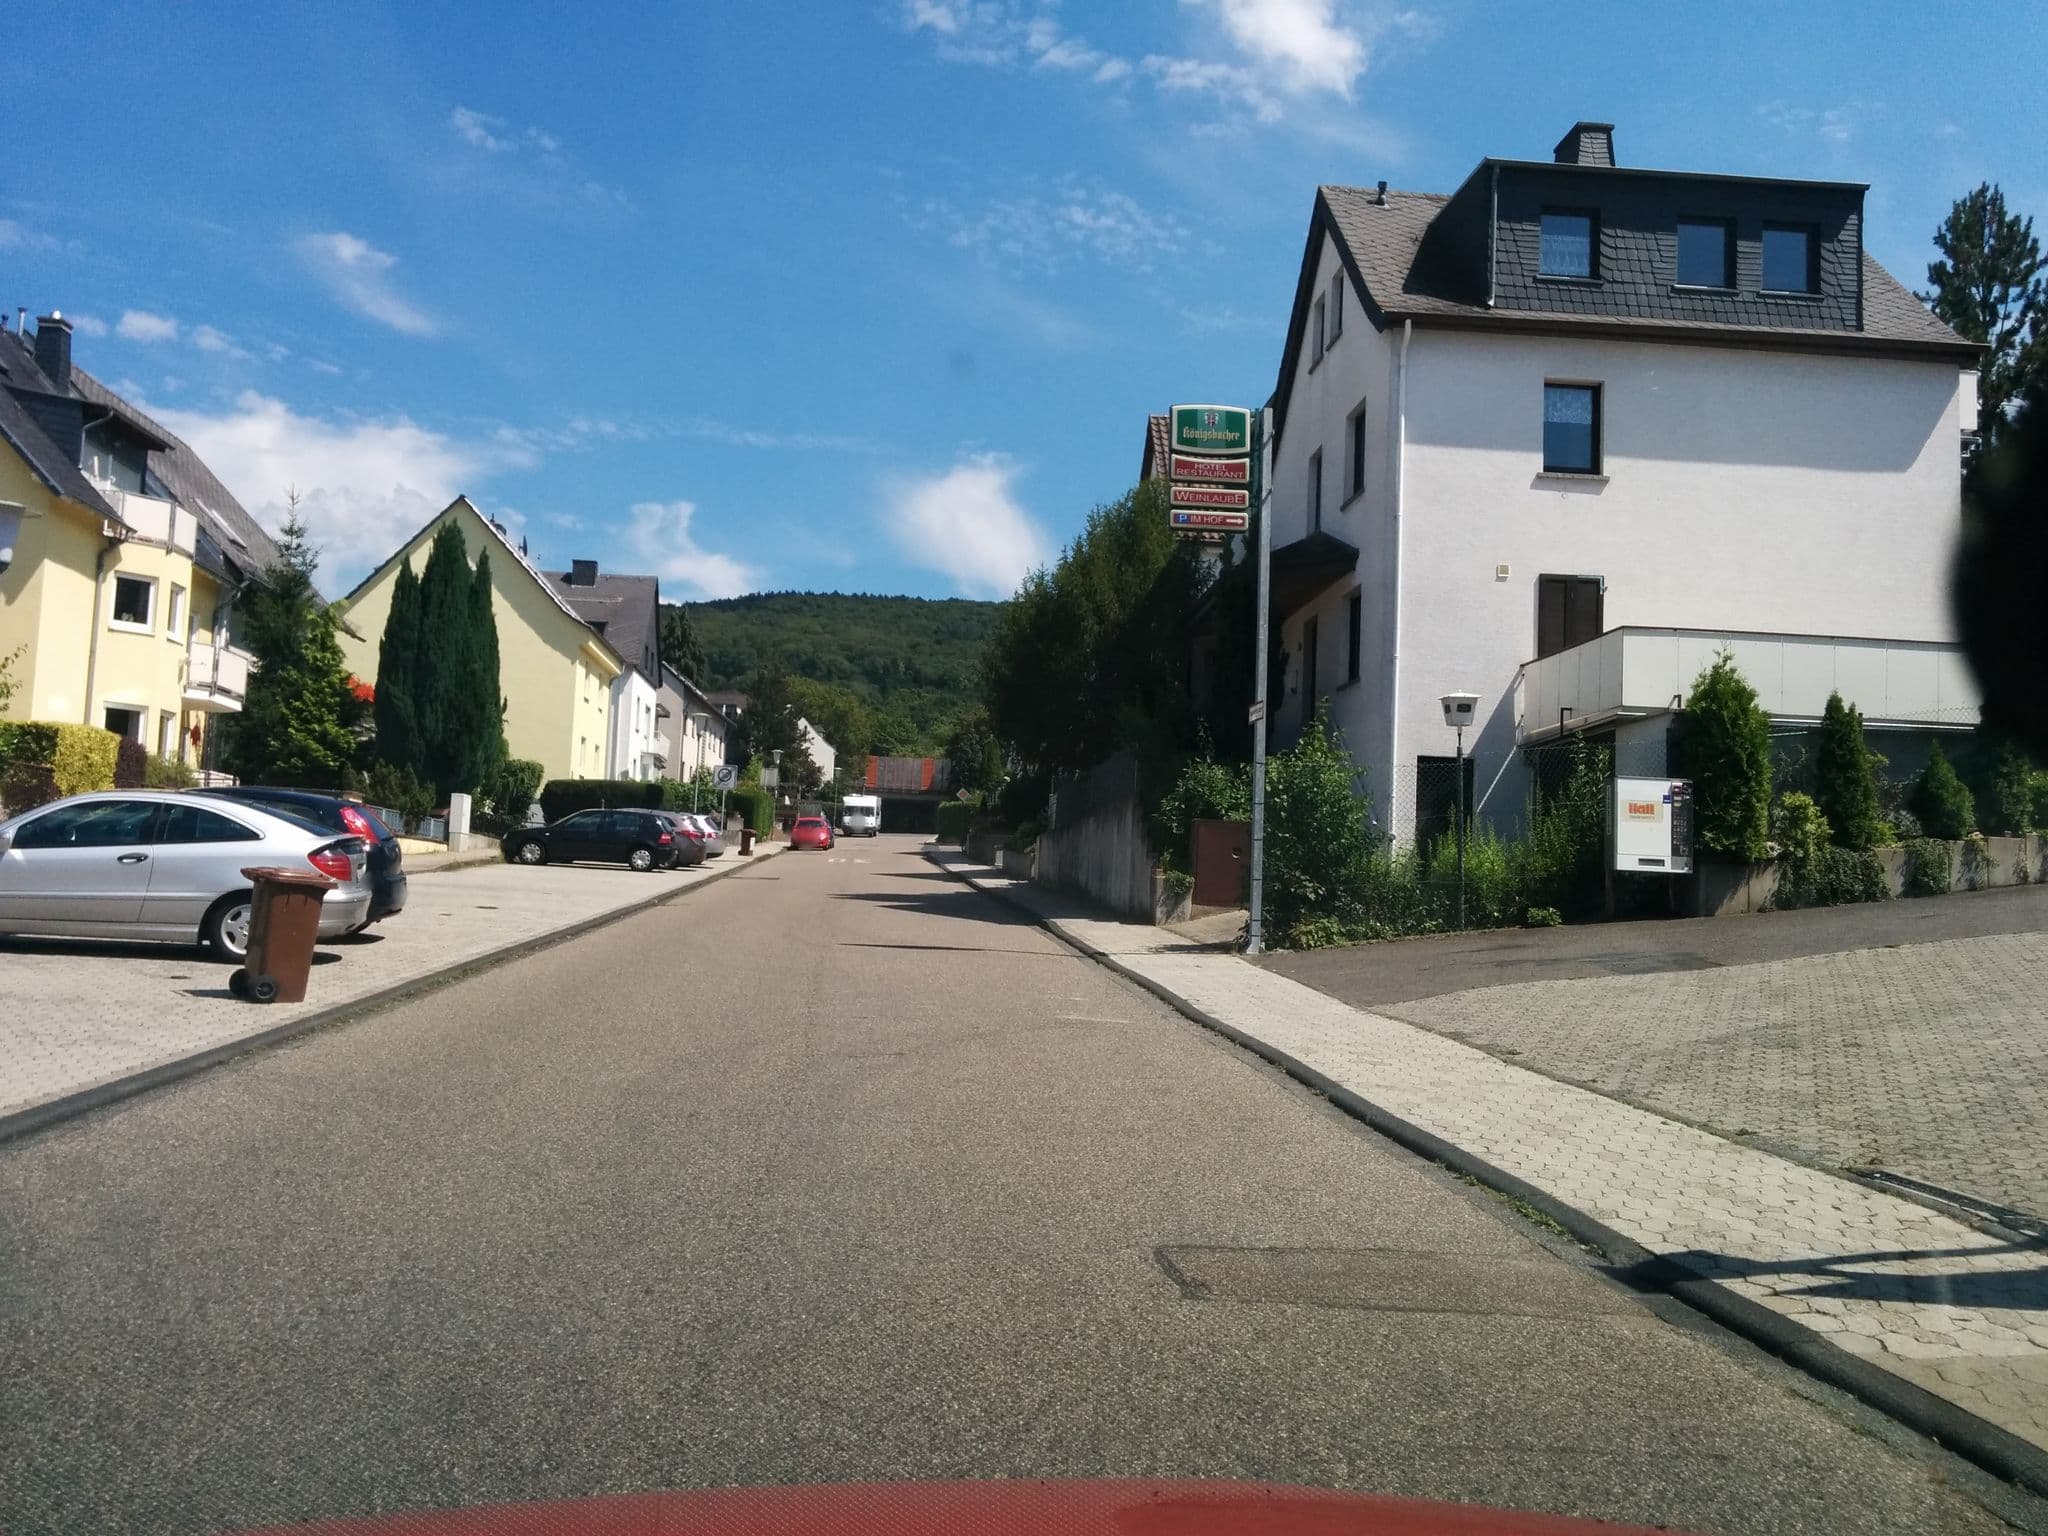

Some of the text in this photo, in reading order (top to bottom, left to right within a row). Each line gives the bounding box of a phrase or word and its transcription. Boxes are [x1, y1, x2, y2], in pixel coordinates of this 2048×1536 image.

[1183, 427, 1240, 441] Königsbacher
[1194, 463, 1227, 471] HOTEL
[1176, 469, 1243, 478] RESTAURANT
[1176, 491, 1243, 503] WEINLAUBE
[1179, 514, 1224, 524] P IM HOF
